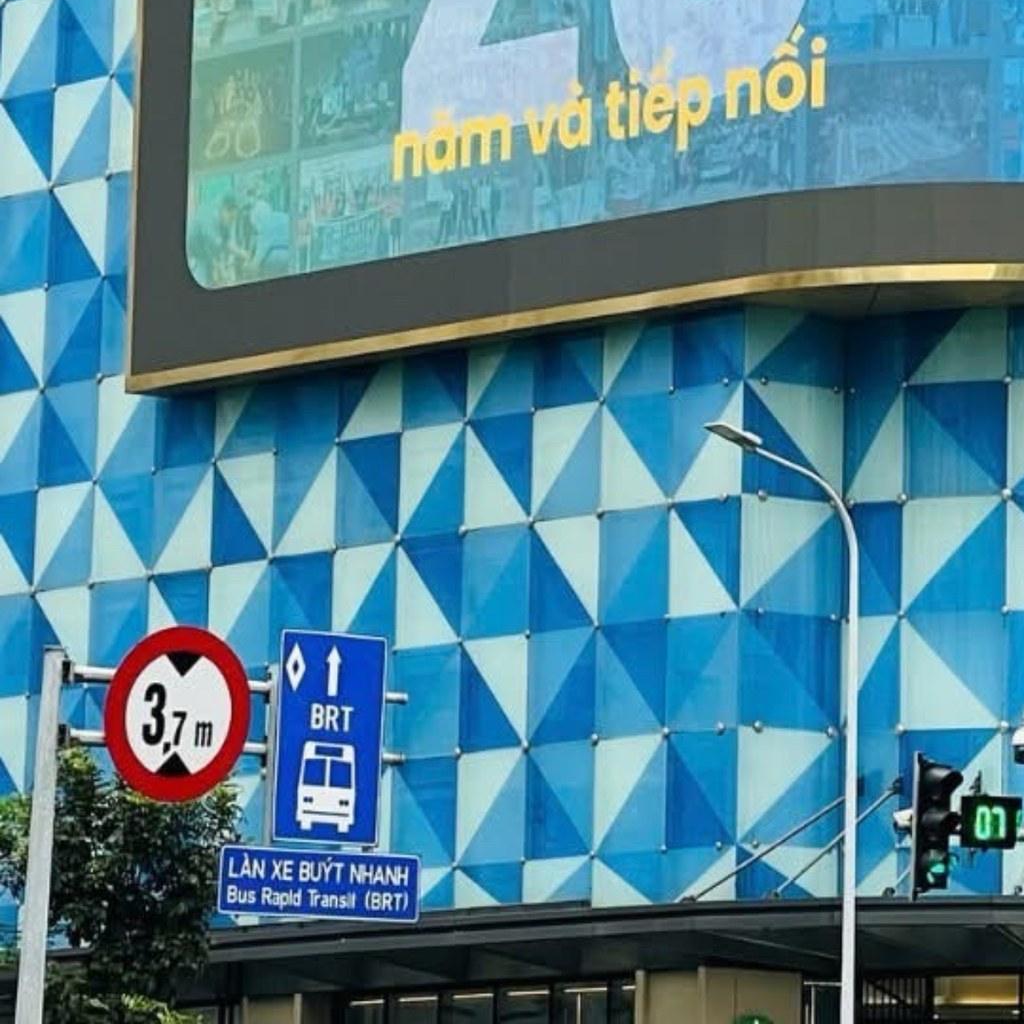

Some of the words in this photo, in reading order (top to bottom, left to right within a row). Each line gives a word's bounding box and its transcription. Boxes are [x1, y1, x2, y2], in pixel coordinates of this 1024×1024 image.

[393, 107, 512, 182] năm
[523, 79, 592, 156] và
[605, 44, 712, 152] tiếp
[725, 22, 827, 119] nối
[311, 703, 353, 733] BRT
[194, 719, 213, 748] m
[228, 853, 265, 880] LÀN
[271, 860, 294, 881] XE
[299, 856, 344, 883] BUÝT
[350, 863, 409, 887] NHANH
[226, 885, 256, 905] Bus
[261, 887, 301, 909] Rapid
[307, 888, 356, 910] Transit
[365, 889, 409, 912] (BRT)
